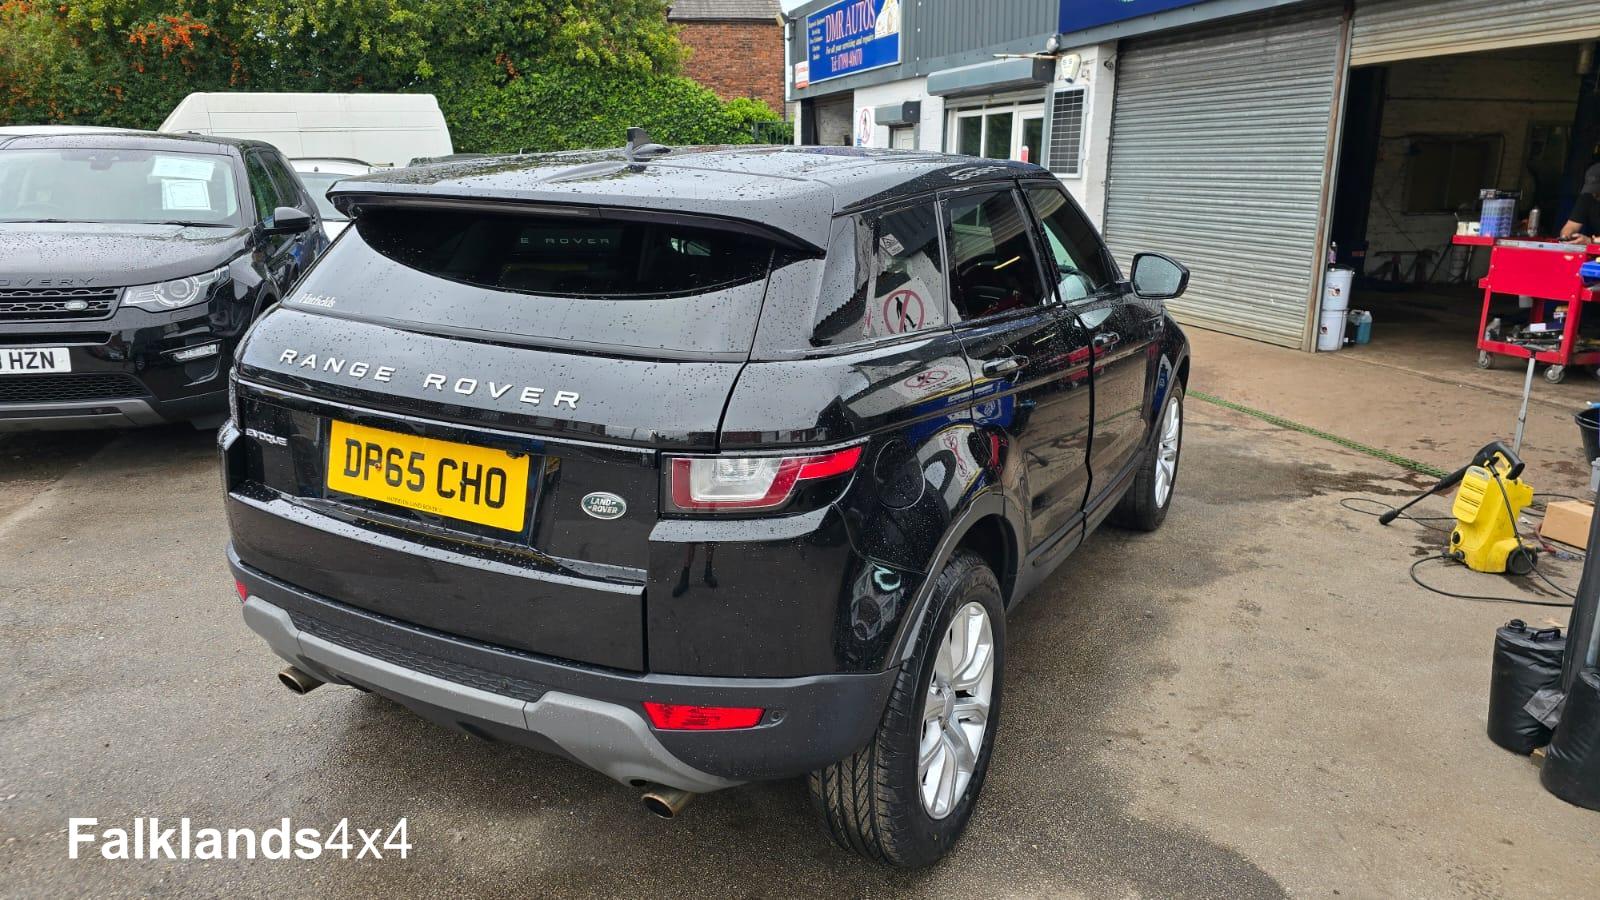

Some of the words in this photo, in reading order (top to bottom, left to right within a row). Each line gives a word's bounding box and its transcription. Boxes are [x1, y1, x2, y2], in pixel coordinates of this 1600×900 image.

[825, 10, 845, 43] DMR
[845, 0, 876, 37] AUTOS
[8, 351, 55, 370] HZN
[279, 349, 396, 382] RANGE
[423, 373, 581, 409] ROVER
[245, 428, 288, 446] EVOQUE
[343, 437, 425, 493] DP65
[436, 457, 507, 509] CHO
